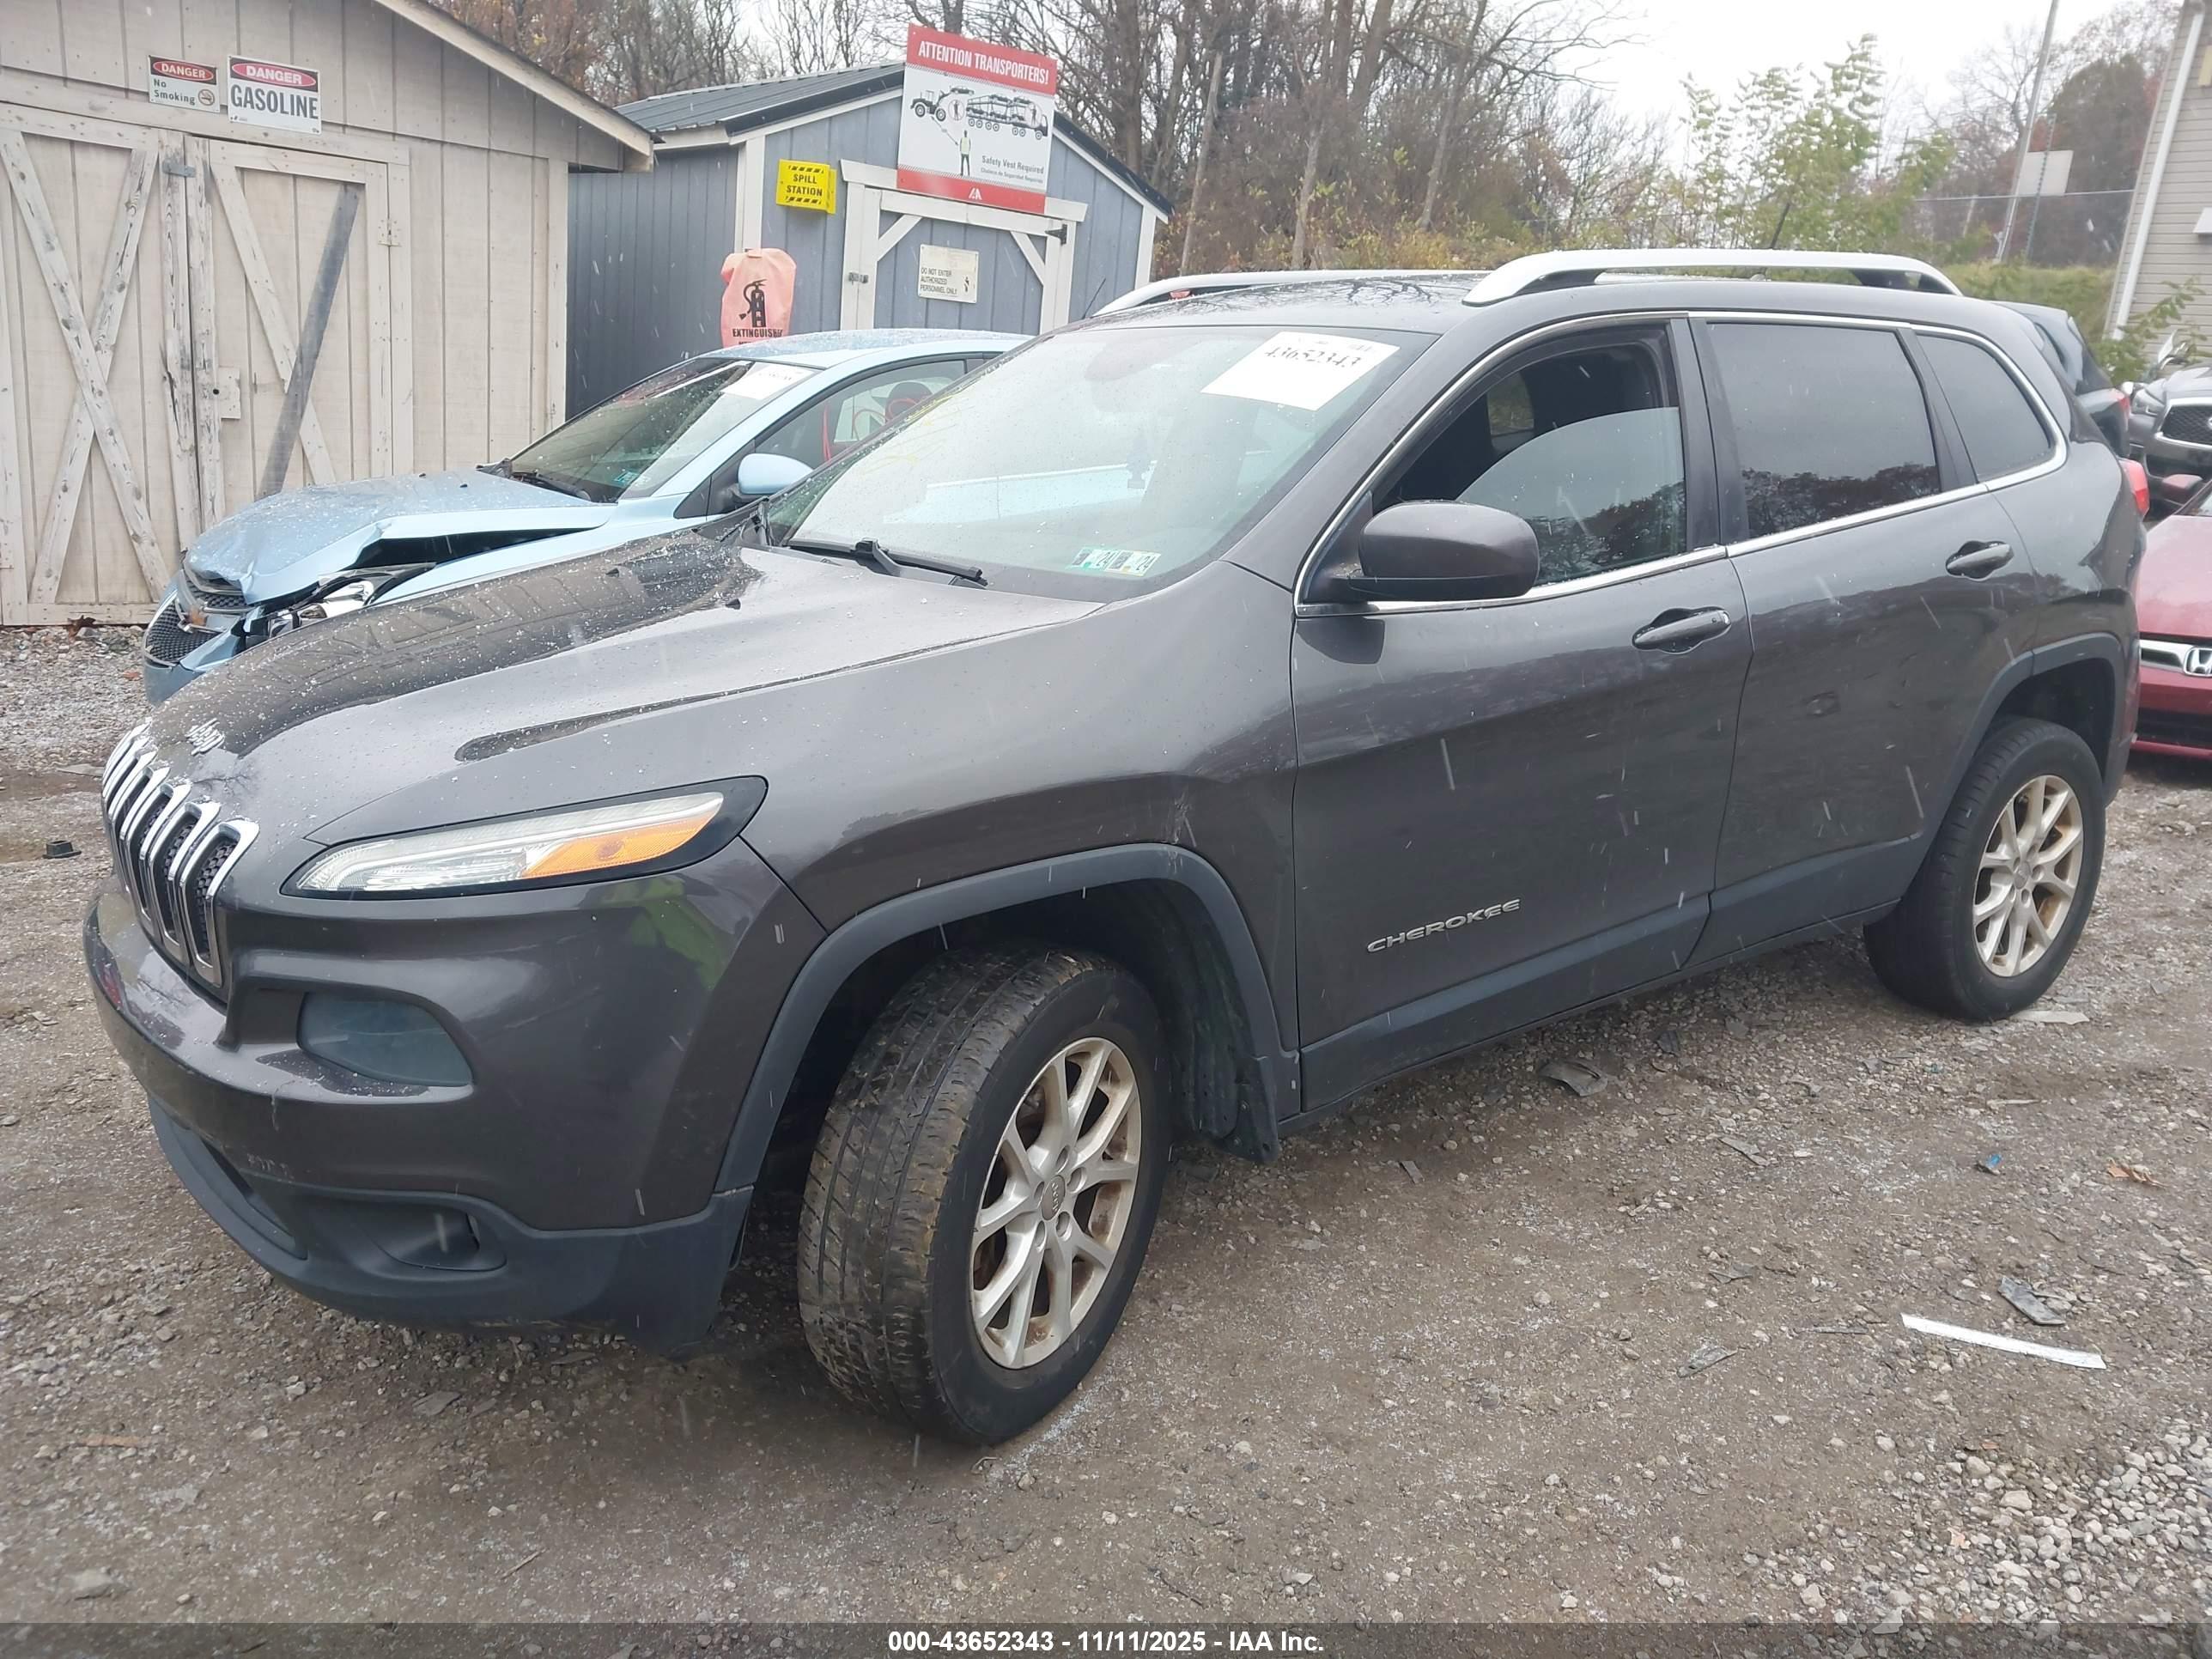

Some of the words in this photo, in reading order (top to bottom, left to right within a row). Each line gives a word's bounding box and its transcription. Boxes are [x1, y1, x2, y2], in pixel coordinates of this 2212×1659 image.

[161, 63, 206, 79] DANGER
[918, 40, 973, 69] ATTENTION
[974, 52, 1049, 85] TRANSPORTERS!
[154, 78, 167, 88] No
[246, 65, 302, 85] DANGER
[154, 89, 196, 106] Smoking
[230, 84, 319, 119] GASOLINE
[981, 155, 1001, 168] Safety
[1002, 159, 1016, 169] Vest
[1017, 161, 1044, 174] Required
[793, 173, 817, 184] SPILL
[786, 185, 823, 197] STATION
[921, 276, 948, 285] AUTHORIZED
[1367, 898, 1521, 953] CHEROKEE
